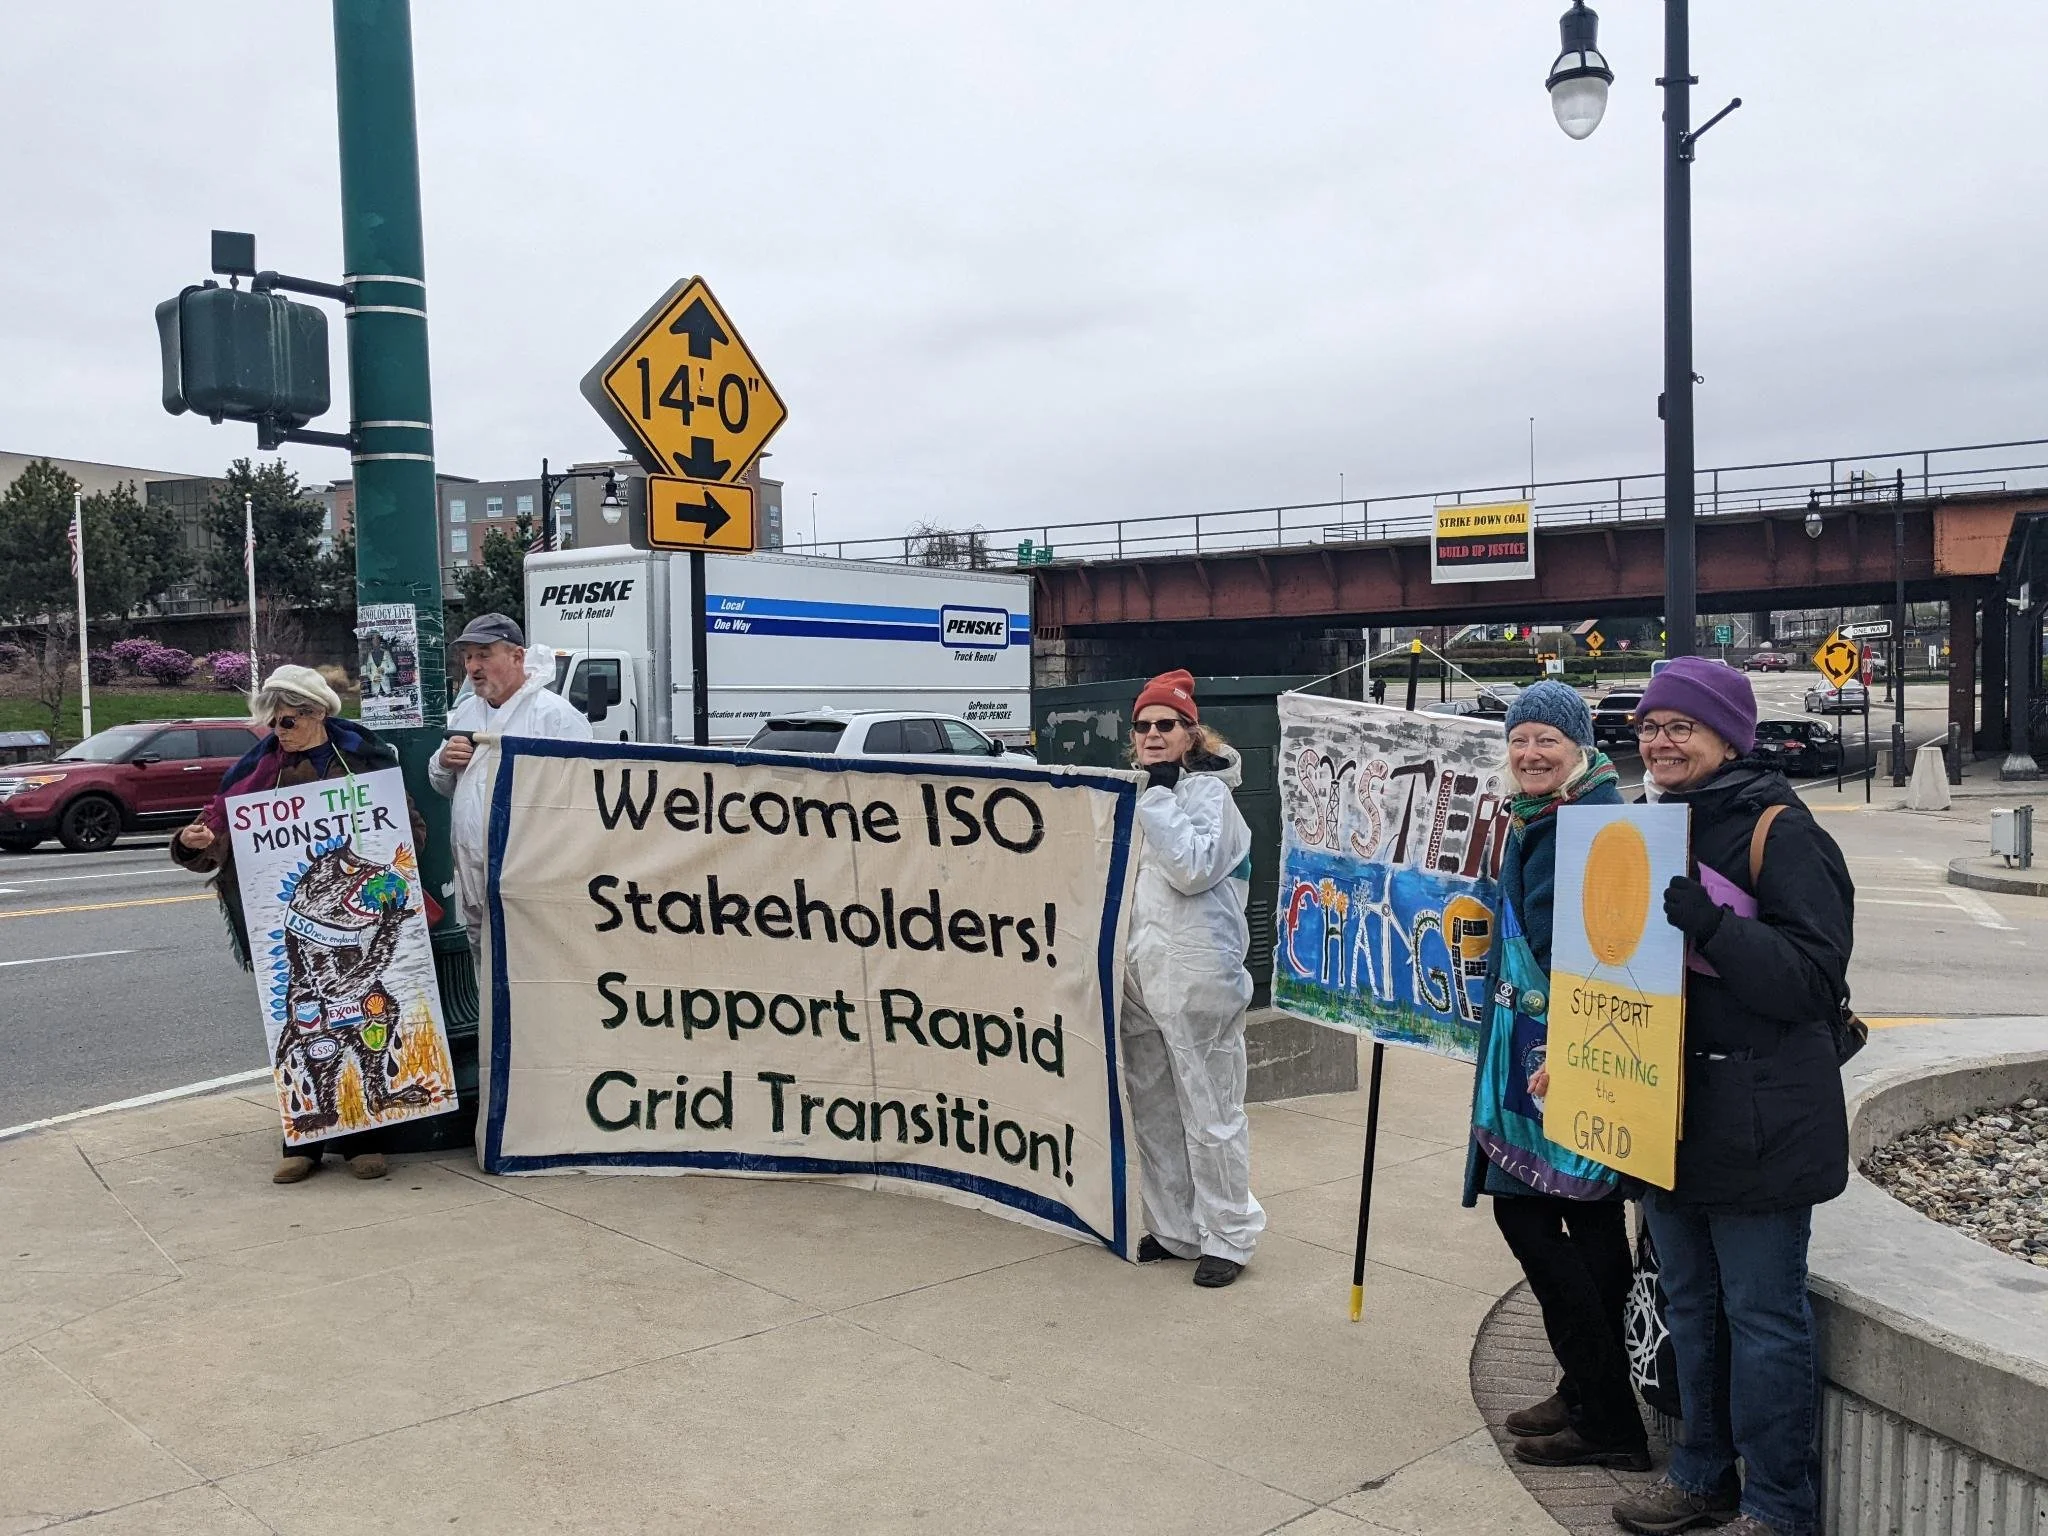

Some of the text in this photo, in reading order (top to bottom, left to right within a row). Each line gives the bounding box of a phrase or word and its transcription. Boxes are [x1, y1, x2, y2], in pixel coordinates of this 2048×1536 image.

[1440, 513, 1526, 528] STRIKE DOWN COAL
[1439, 542, 1526, 559] BUILD UP JUSTICE
[540, 580, 635, 606] PENSKE
[560, 606, 615, 621] Truck Rental
[720, 599, 745, 611] Local
[714, 619, 752, 634] One Way
[946, 620, 1004, 636] PENSKE
[1853, 625, 1886, 635] ONE WAY
[954, 651, 998, 662] Truck Rental
[968, 701, 1008, 710] GoPenske.com
[743, 711, 759, 719] every
[962, 711, 1012, 720] 1-800-GO-PENSKE
[233, 784, 373, 831] STOP THE
[593, 768, 1046, 854] Welcome ISO
[252, 806, 398, 853] MONSTER
[289, 914, 314, 934] ISO
[586, 874, 1057, 969] Stakeholders!
[329, 1006, 360, 1020] EXXON
[1571, 988, 1654, 1029] SUPPORT
[596, 971, 1065, 1079] Support Rapid
[311, 1044, 334, 1057] ESSO
[1567, 1042, 1659, 1087] GREENING
[1596, 1079, 1616, 1103] the
[585, 1069, 1077, 1187] Grid Transition!
[1573, 1110, 1632, 1159] GRID
